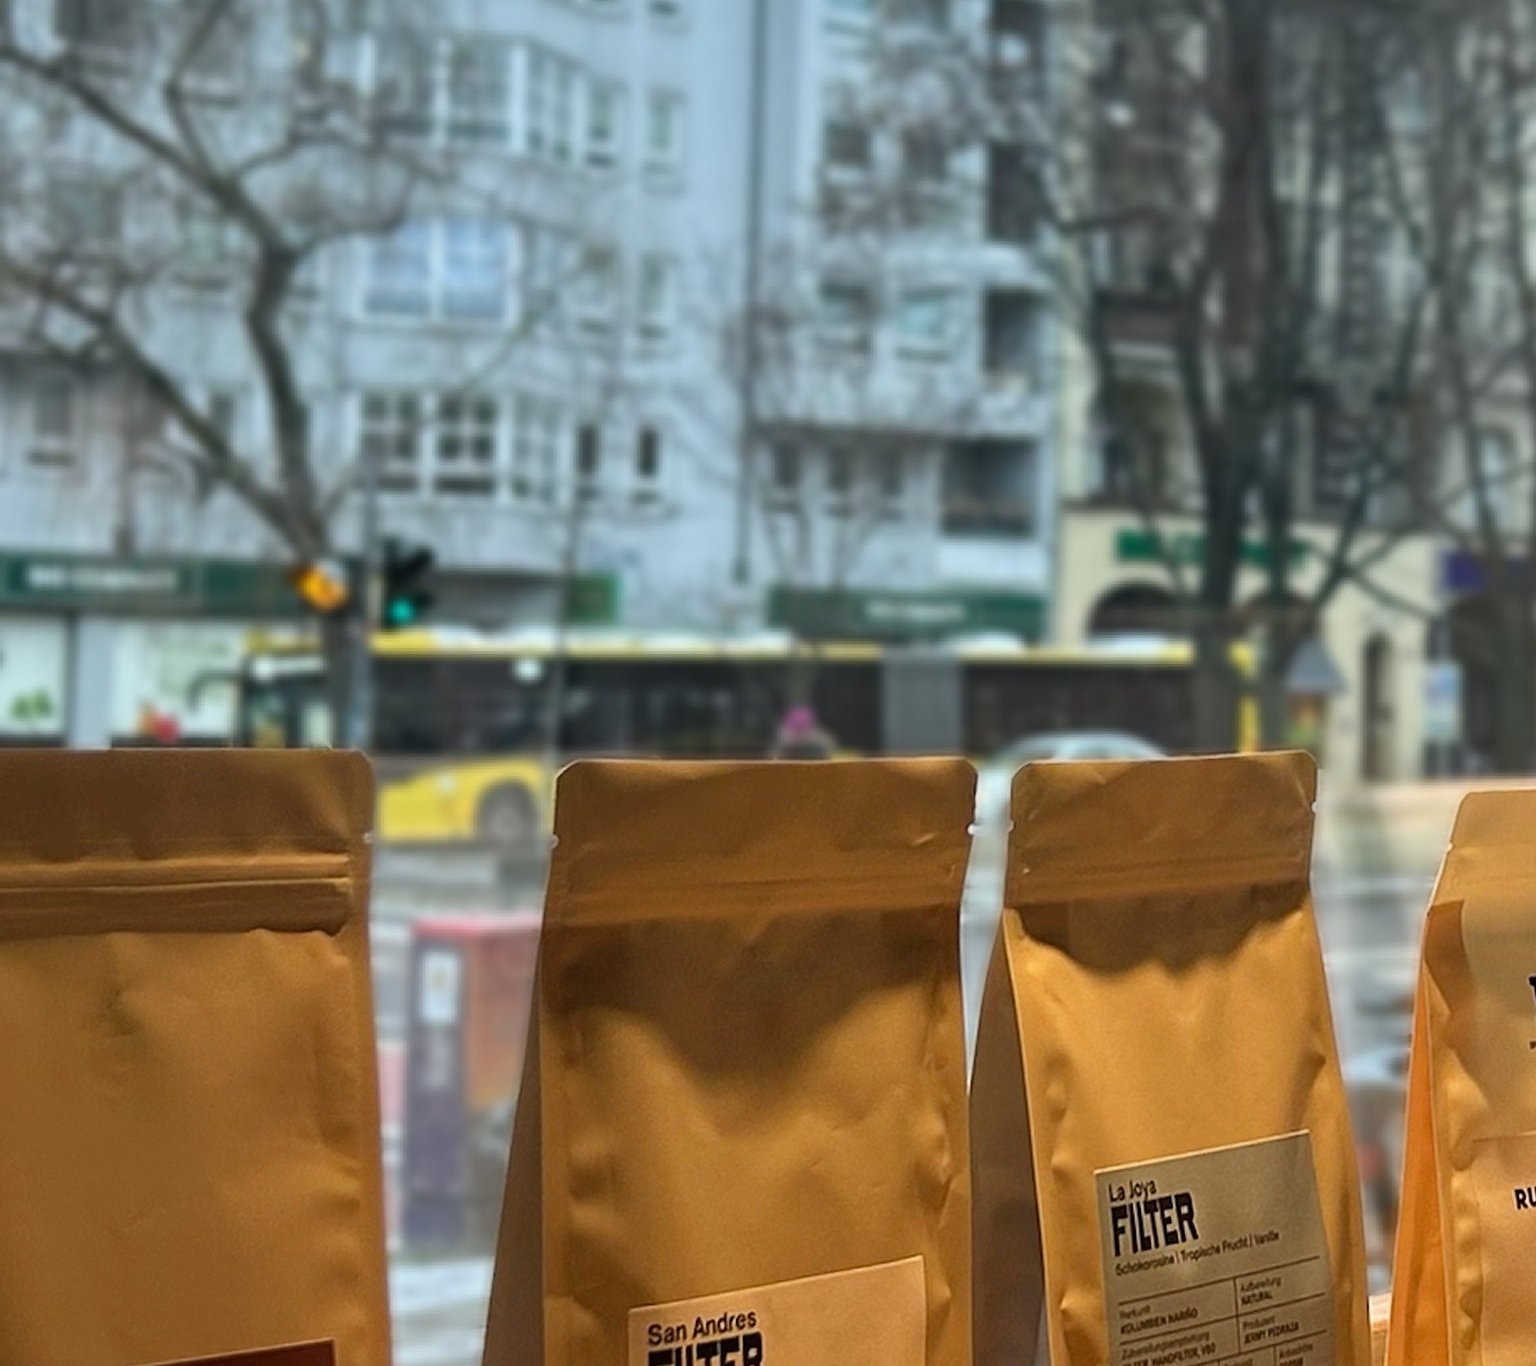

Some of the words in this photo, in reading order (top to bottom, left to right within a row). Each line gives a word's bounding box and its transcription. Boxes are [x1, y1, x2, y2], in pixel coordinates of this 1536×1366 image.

[1109, 1183, 1125, 1203] La
[1130, 1179, 1156, 1200] Joya
[1111, 1192, 1199, 1257] FILTER
[1181, 1243, 1221, 1261] Tropische
[1222, 1238, 1248, 1253] Frucht
[1254, 1230, 1280, 1245] Vanille
[1241, 1291, 1273, 1306] NATURAL
[648, 1324, 688, 1346] San
[692, 1311, 757, 1339] Andres
[1120, 1314, 1167, 1335] KOLUMBIEN
